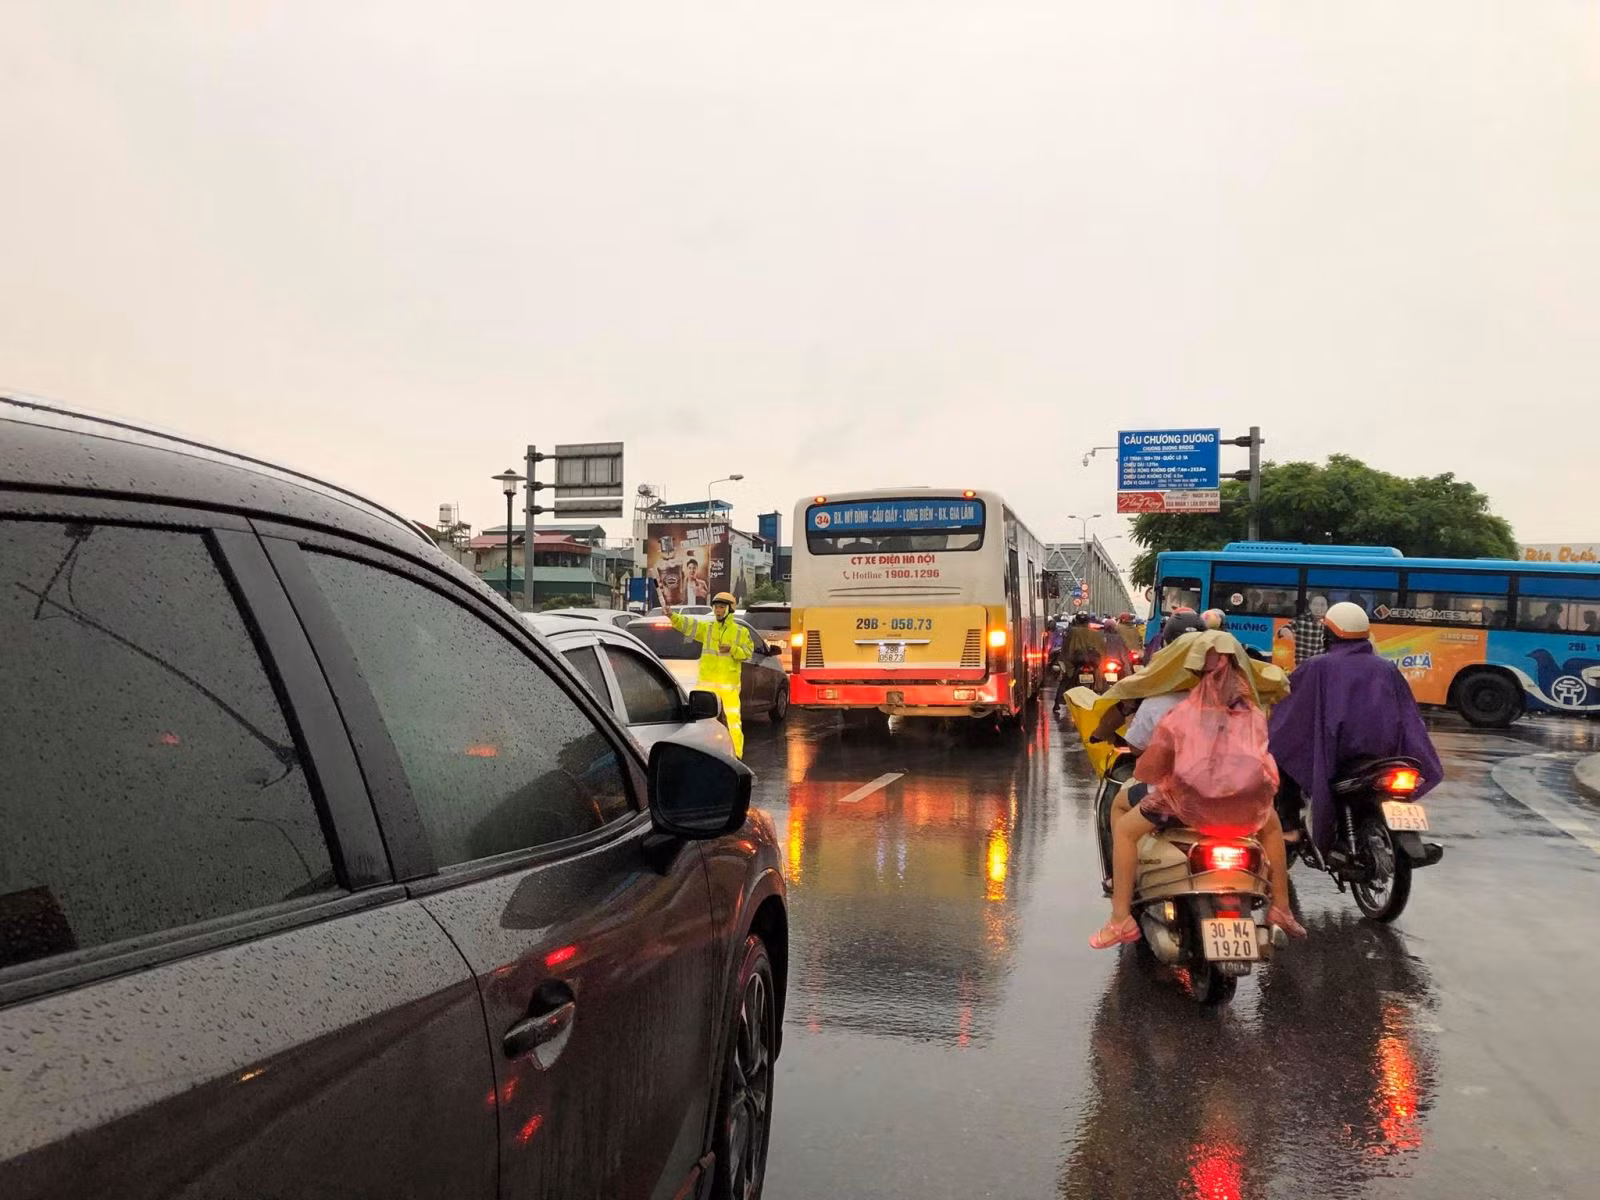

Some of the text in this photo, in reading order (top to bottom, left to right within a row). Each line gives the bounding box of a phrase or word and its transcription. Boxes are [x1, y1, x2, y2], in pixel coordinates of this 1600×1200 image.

[816, 515, 829, 525] 34
[903, 508, 918, 522] LONG
[851, 556, 863, 565] CT
[865, 556, 876, 564] XE
[852, 569, 940, 579] Hotline 1900.1296
[856, 618, 878, 630] 29B
[891, 618, 932, 630] 058.73
[1214, 940, 1251, 957] 1920
